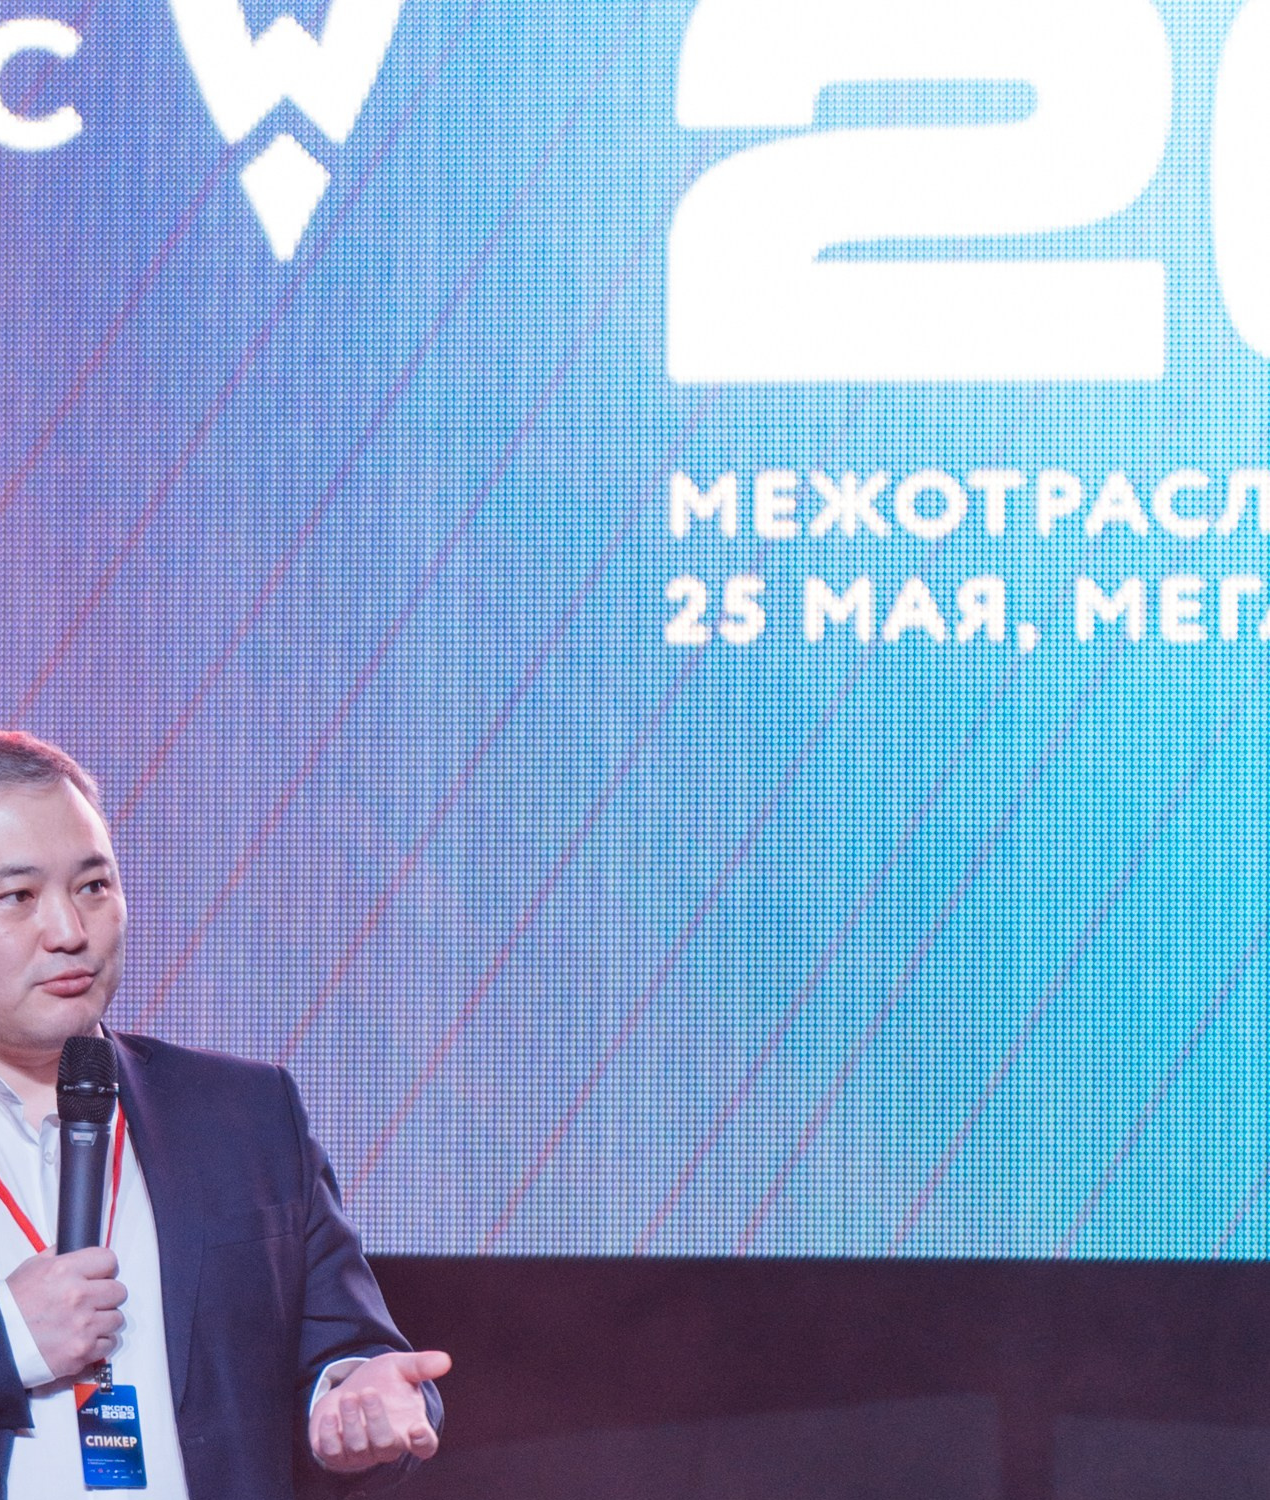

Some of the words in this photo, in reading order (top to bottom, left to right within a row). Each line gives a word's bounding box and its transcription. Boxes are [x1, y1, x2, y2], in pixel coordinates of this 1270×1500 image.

[667, 0, 1270, 383] 2
[668, 468, 1270, 539] МЕЖОТРАСЛ
[664, 574, 767, 645] 25
[803, 574, 1039, 653] МАЯ,
[1074, 574, 1270, 643] МЕГ
[85, 1435, 138, 1448] СПИКЕР
[102, 1411, 136, 1419] 2023
